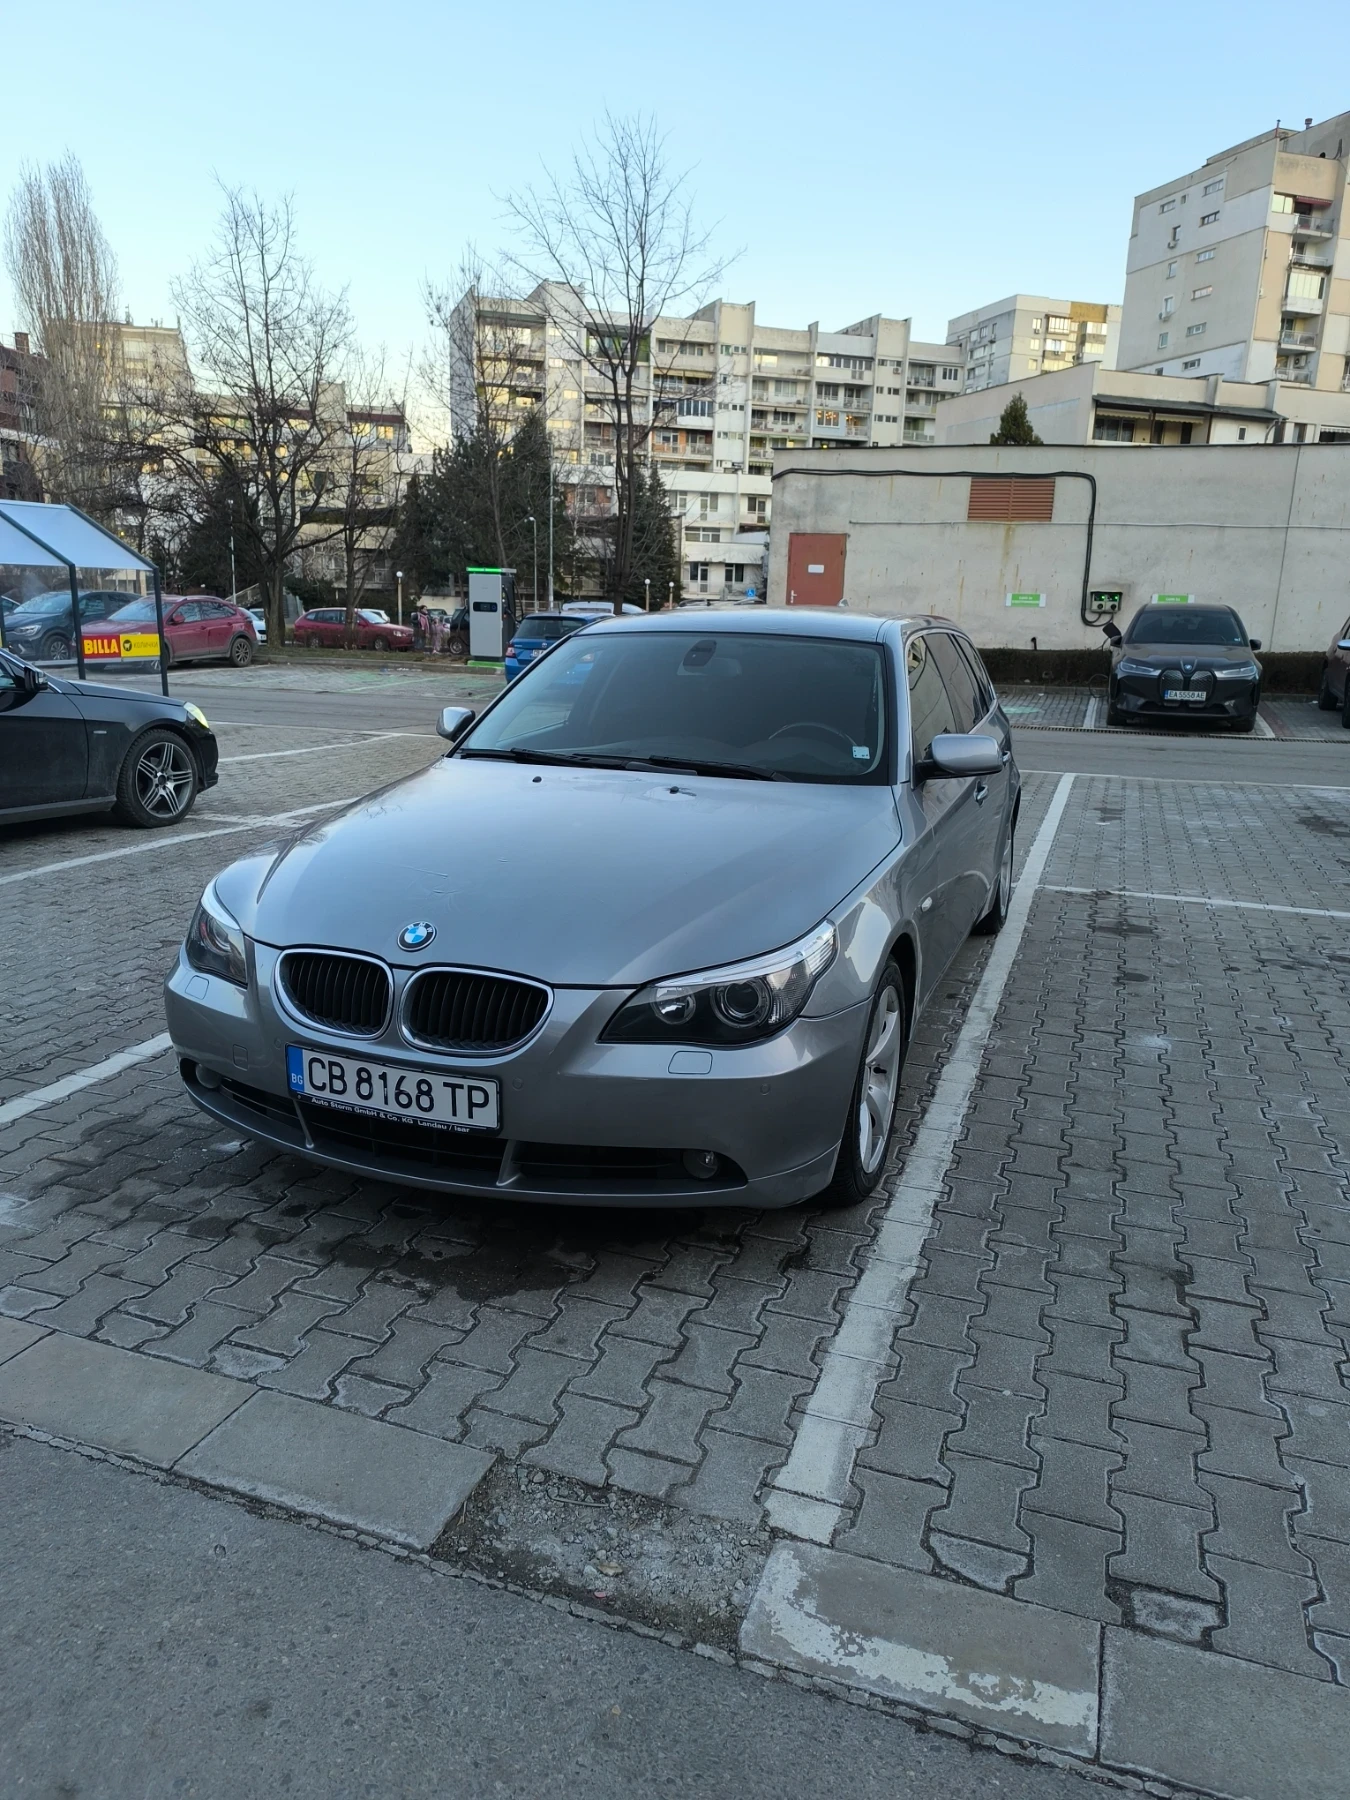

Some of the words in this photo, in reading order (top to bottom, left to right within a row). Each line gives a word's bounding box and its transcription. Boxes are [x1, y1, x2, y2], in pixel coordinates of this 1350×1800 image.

[84, 639, 119, 654] BILLA
[291, 1072, 304, 1085] BG
[308, 1057, 347, 1096] CB
[355, 1066, 435, 1113] 8168
[442, 1081, 490, 1119] TP
[311, 1097, 329, 1106] Auto
[330, 1100, 352, 1112] Storm
[354, 1106, 377, 1117] GmbH
[387, 1114, 400, 1122] Co.
[417, 1119, 447, 1130] Landau
[454, 1125, 470, 1133] Isar
